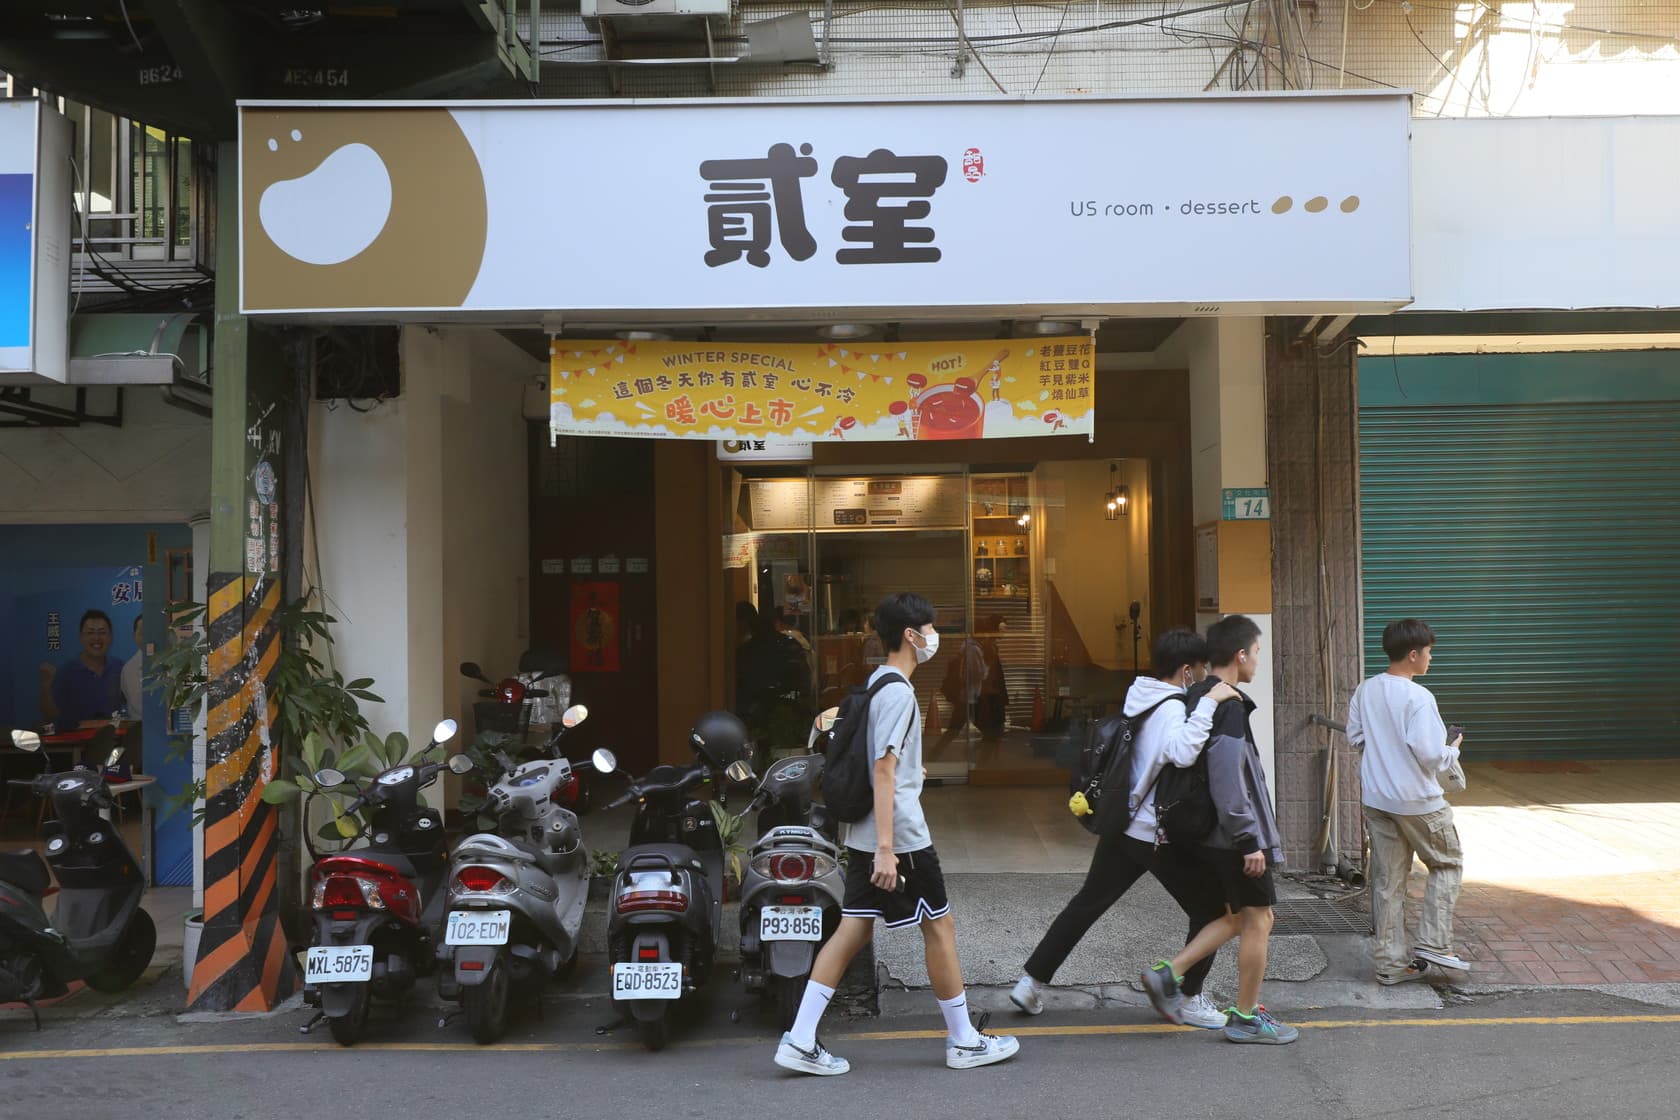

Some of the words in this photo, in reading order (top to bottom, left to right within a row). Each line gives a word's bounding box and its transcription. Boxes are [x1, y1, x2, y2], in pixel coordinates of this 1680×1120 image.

[700, 142, 948, 268] 貳室
[1071, 201, 1097, 216] US
[1105, 203, 1153, 216] room
[1180, 200, 1261, 215] dessert
[662, 351, 726, 368] WINTER
[731, 352, 796, 372] SPECIAL
[931, 355, 963, 372] HOT!
[613, 370, 779, 399] 這個冬天你有貳室
[791, 377, 856, 404] 心不冷
[665, 395, 795, 424] 暖心上市
[1244, 499, 1263, 517] 14
